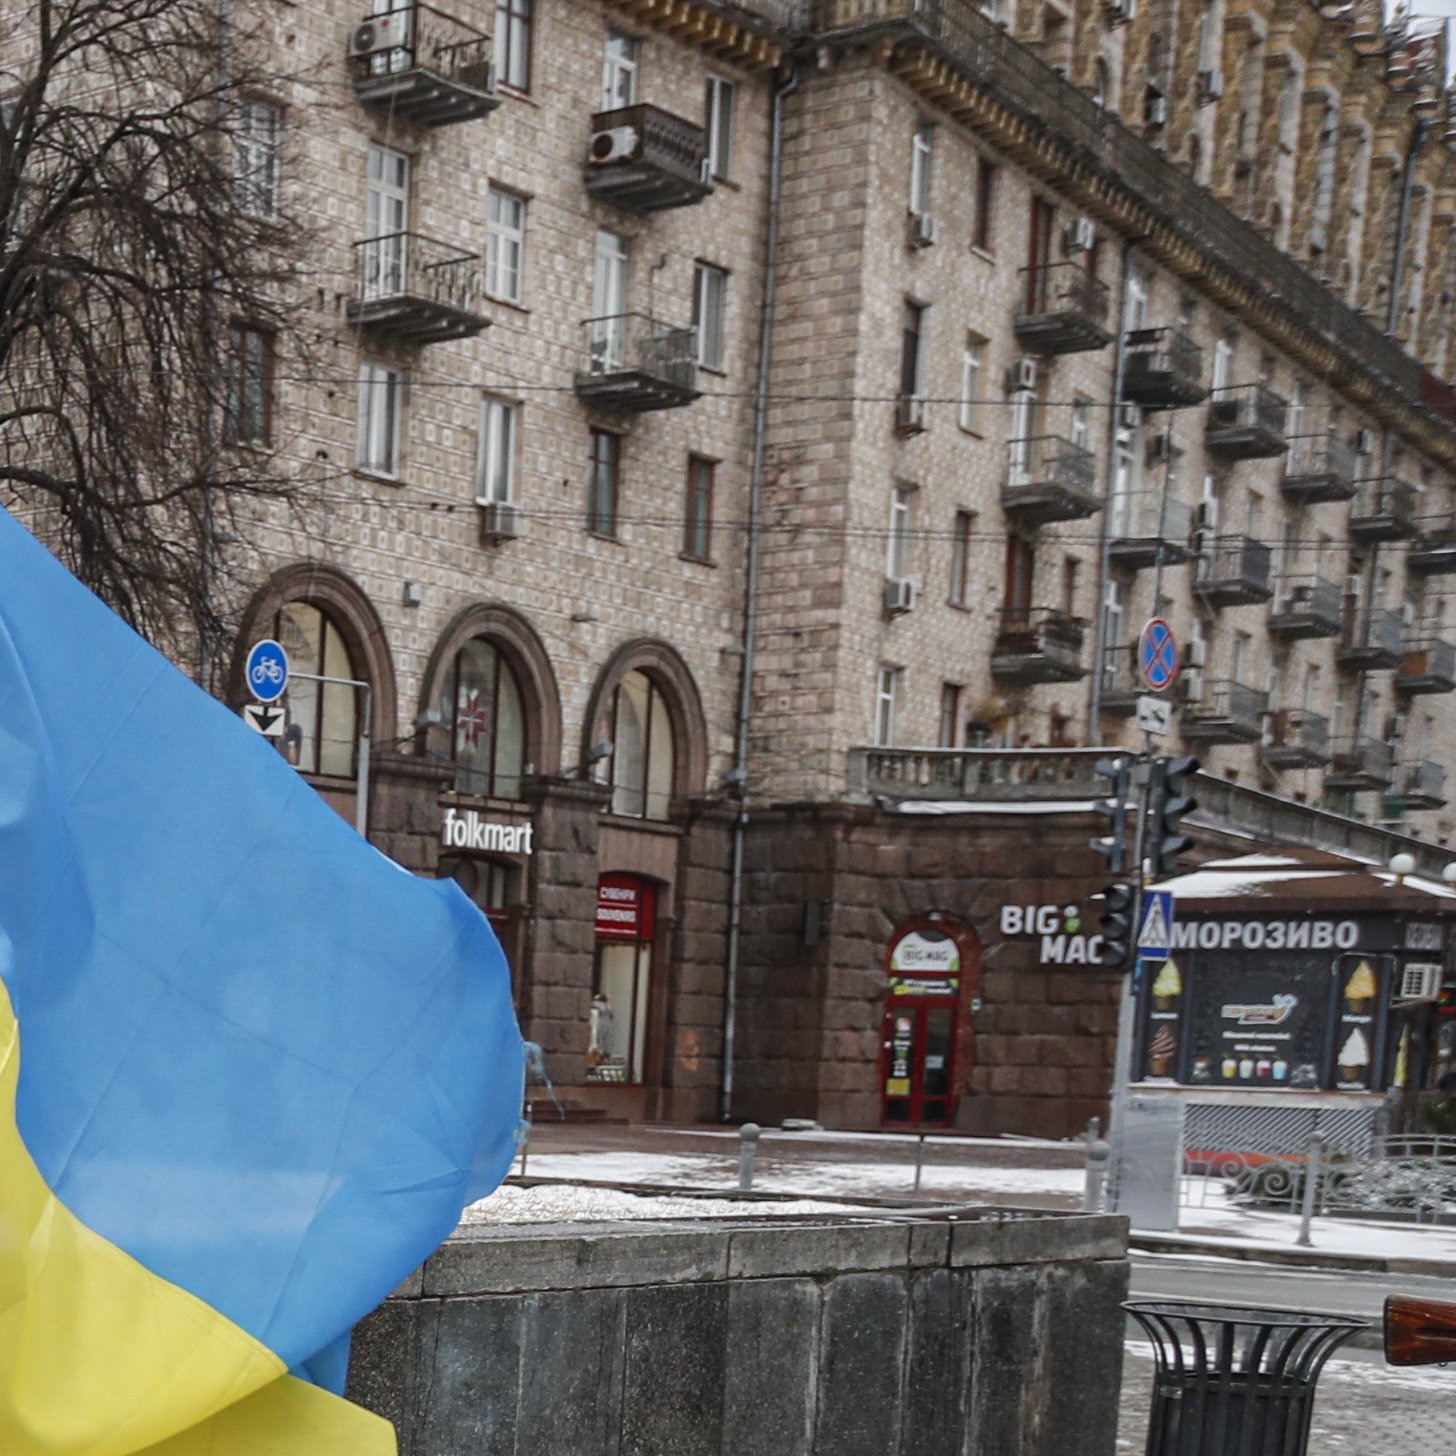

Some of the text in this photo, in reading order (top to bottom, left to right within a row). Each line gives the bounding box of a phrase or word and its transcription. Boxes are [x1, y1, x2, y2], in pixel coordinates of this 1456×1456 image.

[443, 807, 533, 855] folkmart
[1000, 905, 1060, 934] BIG
[1169, 920, 1359, 949] МОРОЗИВО
